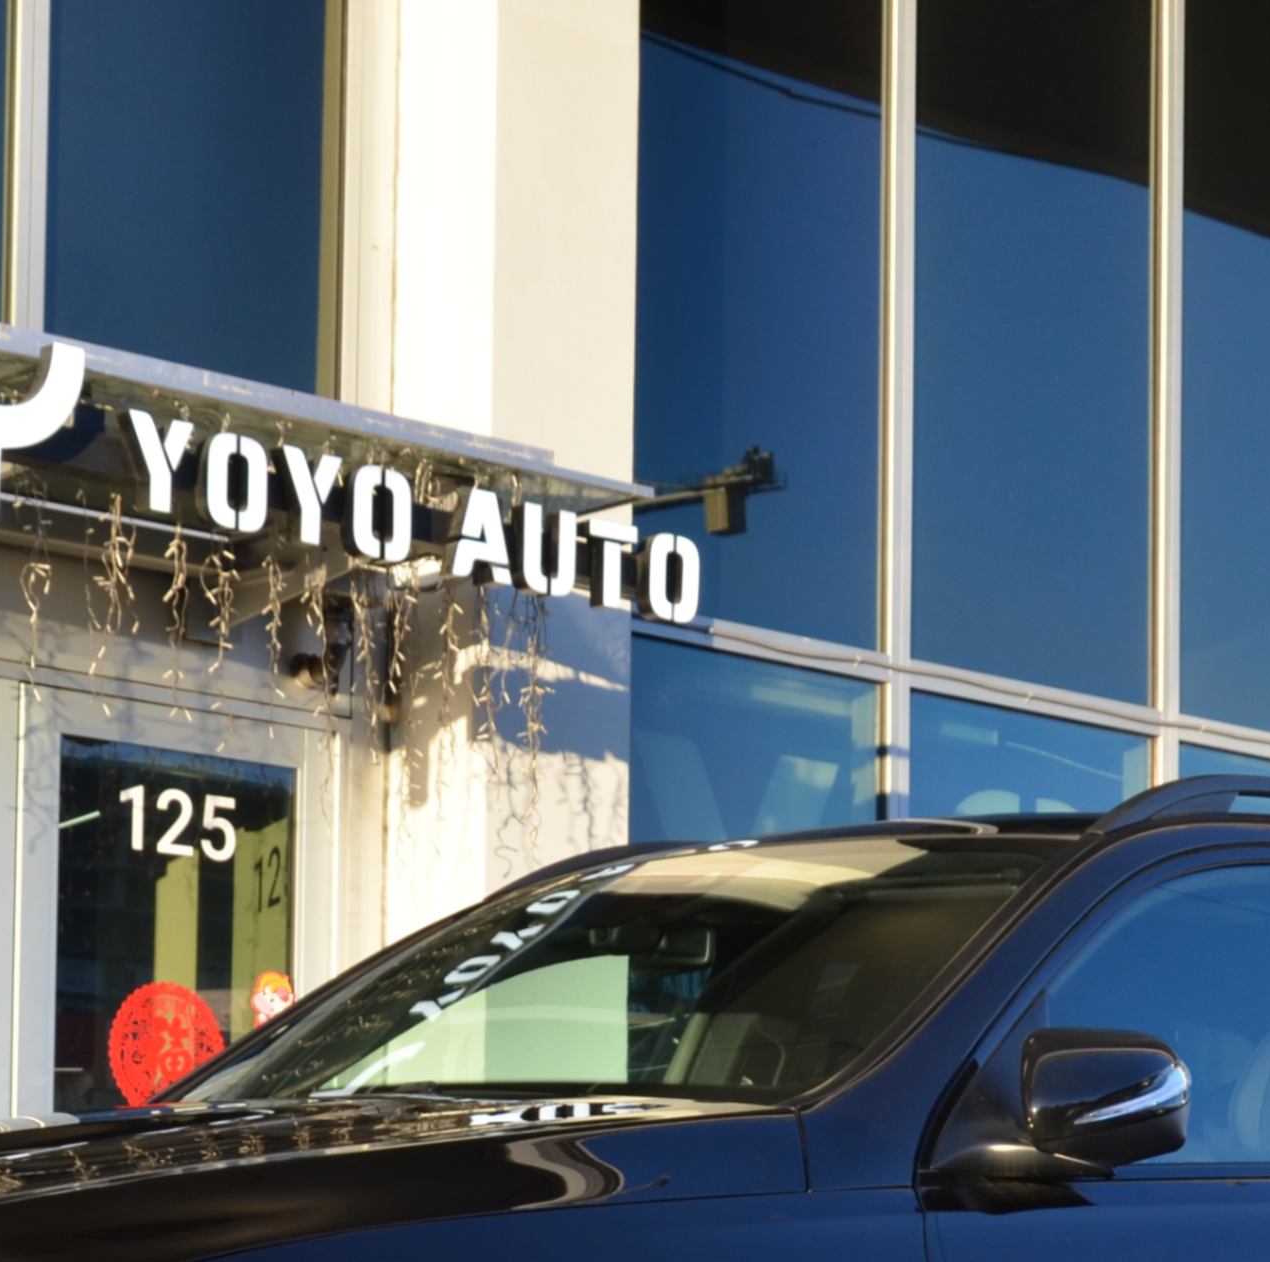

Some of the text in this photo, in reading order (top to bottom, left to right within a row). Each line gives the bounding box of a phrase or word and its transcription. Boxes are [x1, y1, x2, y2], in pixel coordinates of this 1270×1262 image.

[127, 408, 701, 624] YOYO AUTO
[119, 783, 237, 862] 125
